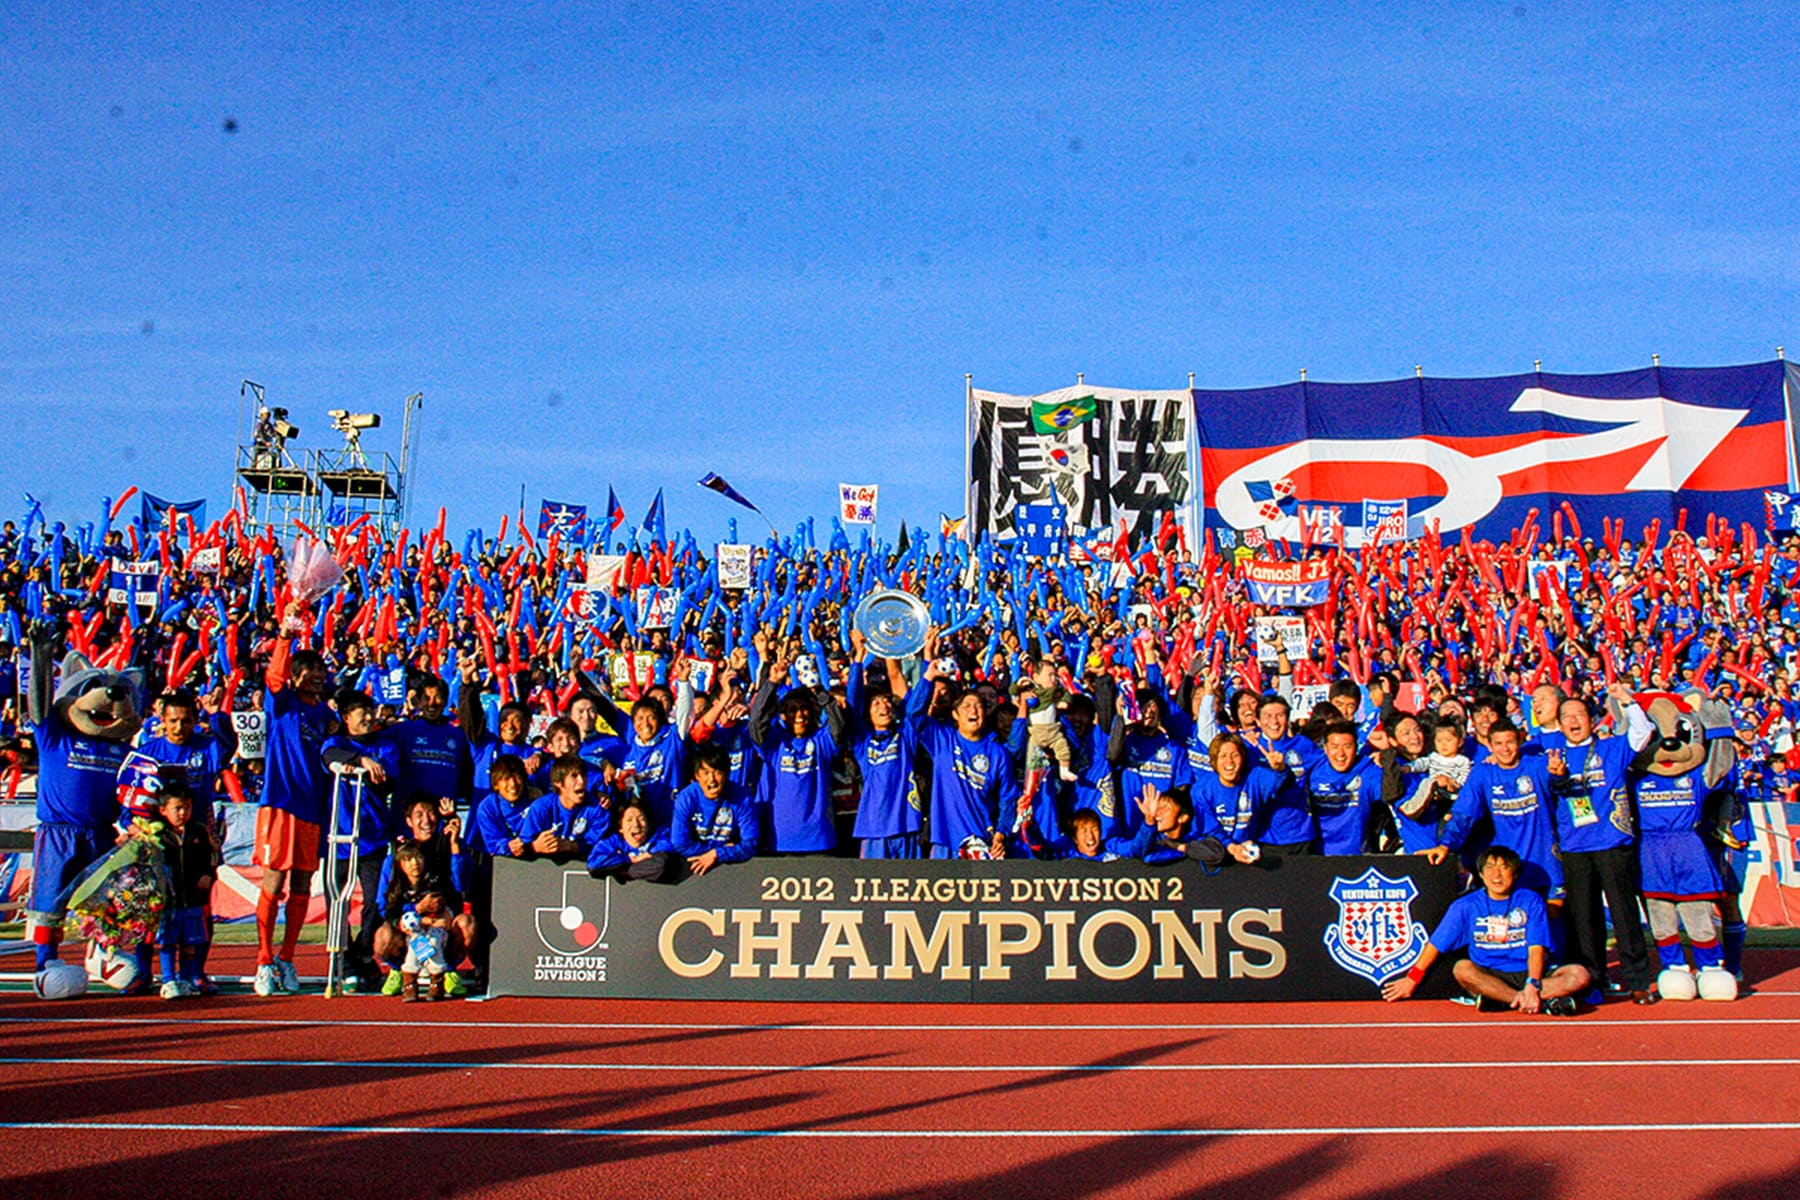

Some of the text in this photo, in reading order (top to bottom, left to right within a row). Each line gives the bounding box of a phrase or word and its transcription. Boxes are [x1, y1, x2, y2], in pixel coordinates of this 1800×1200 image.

[1302, 509, 1343, 526] VFK
[1243, 559, 1329, 581] Vamos!! J1
[1256, 584, 1315, 605] VFK
[236, 714, 261, 730] 30
[263, 844, 270, 865] 1
[761, 877, 1184, 902] 2012 J.LEAGUE DIVISION 2
[658, 906, 1287, 980] CHAMPIONS
[535, 956, 607, 969] J.LEAGUE
[534, 969, 606, 981] DIVISION 2
